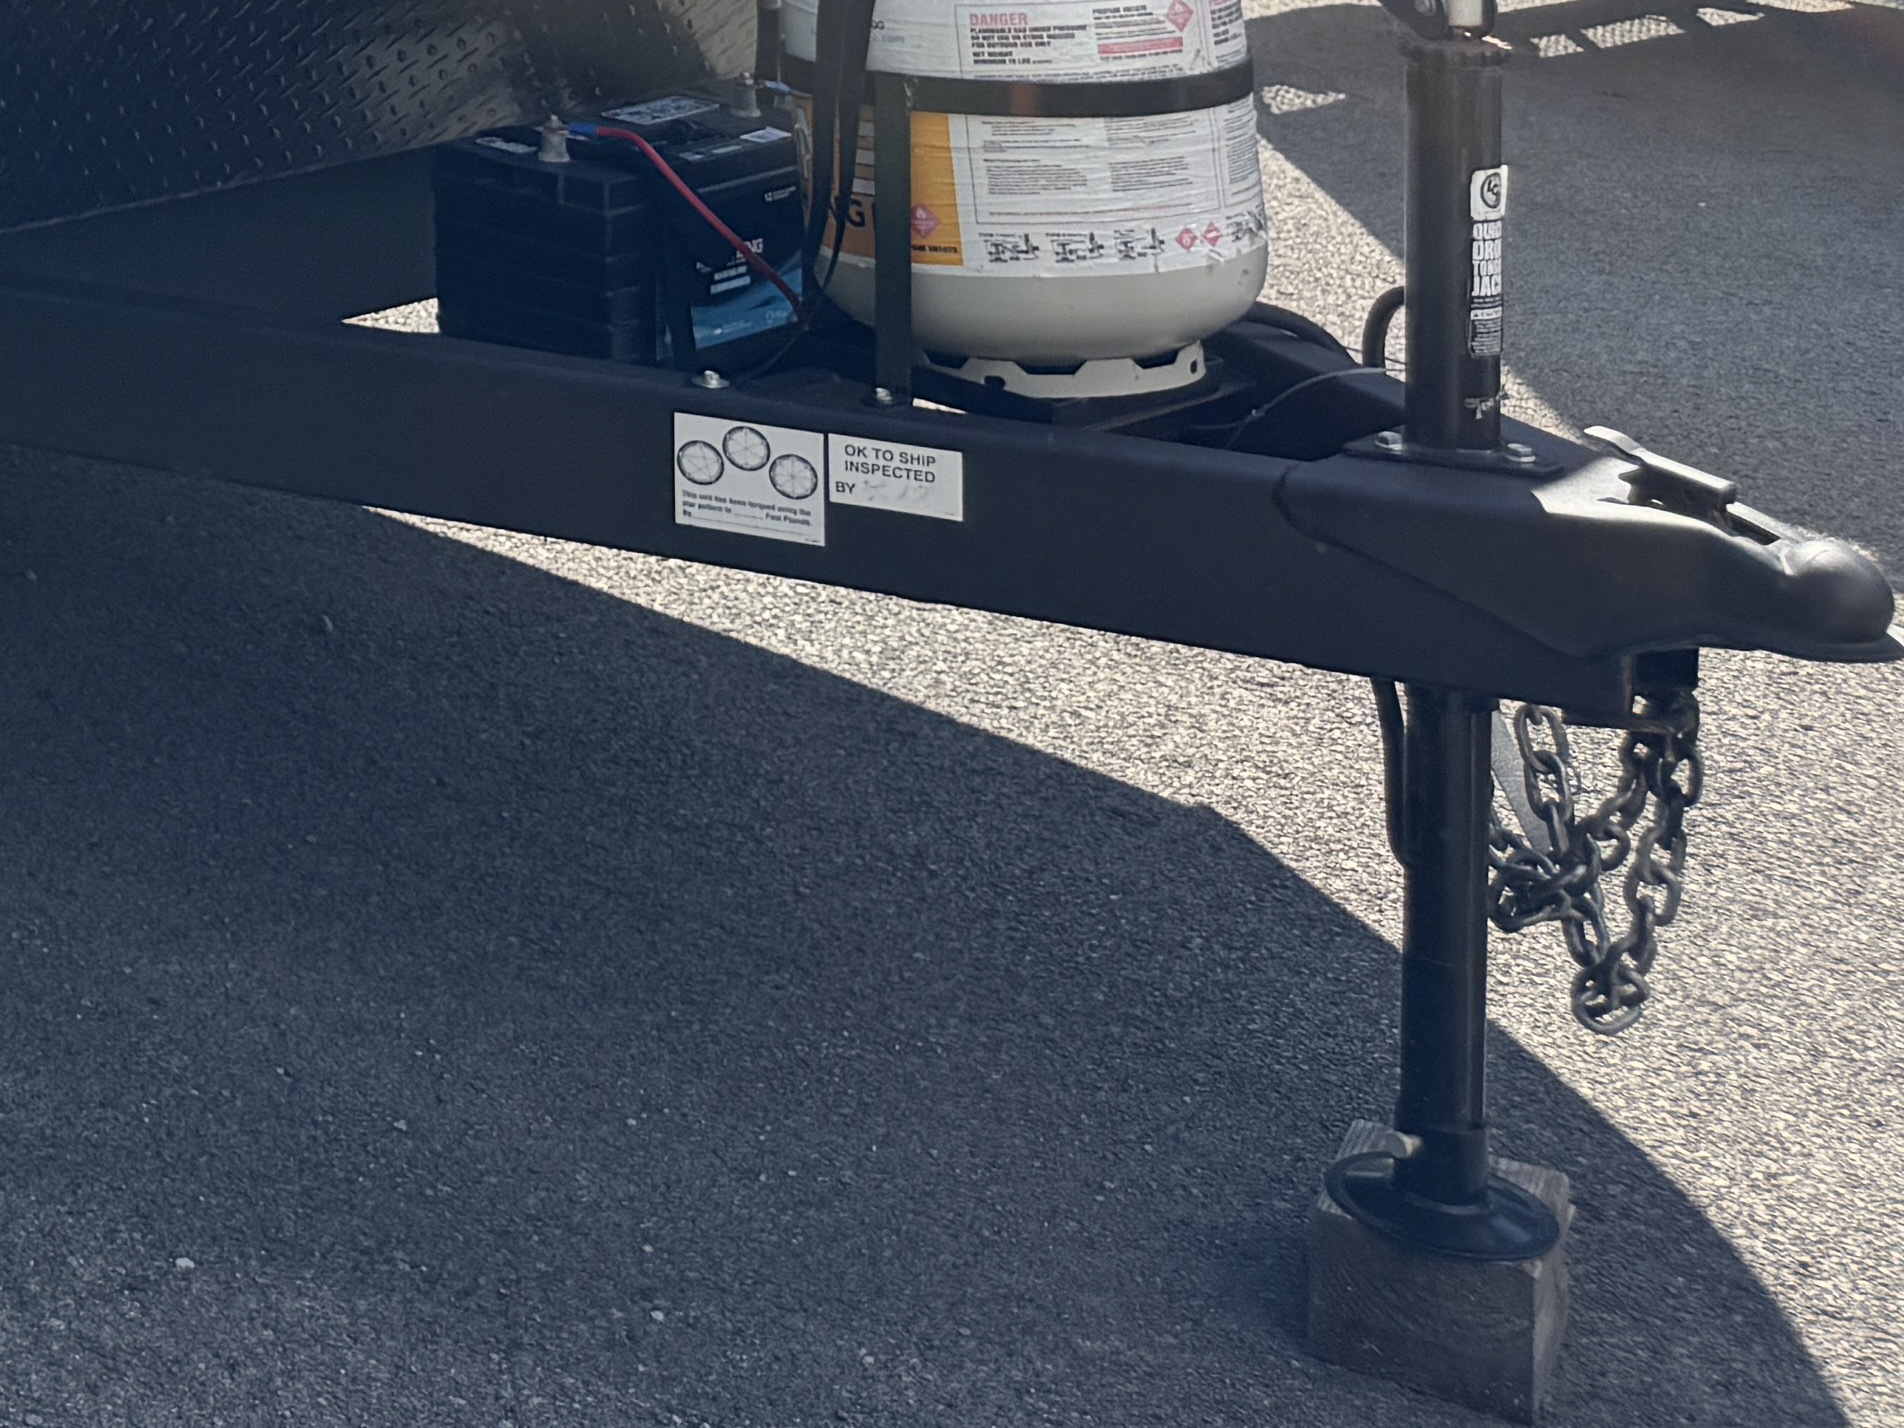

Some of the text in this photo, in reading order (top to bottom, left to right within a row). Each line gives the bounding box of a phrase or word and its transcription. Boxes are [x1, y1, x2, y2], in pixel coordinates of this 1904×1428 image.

[968, 13, 1028, 26] DANGER
[844, 444, 937, 467] OK TO SHIP
[844, 460, 936, 483] INSPECTED
[835, 481, 856, 494] BY
